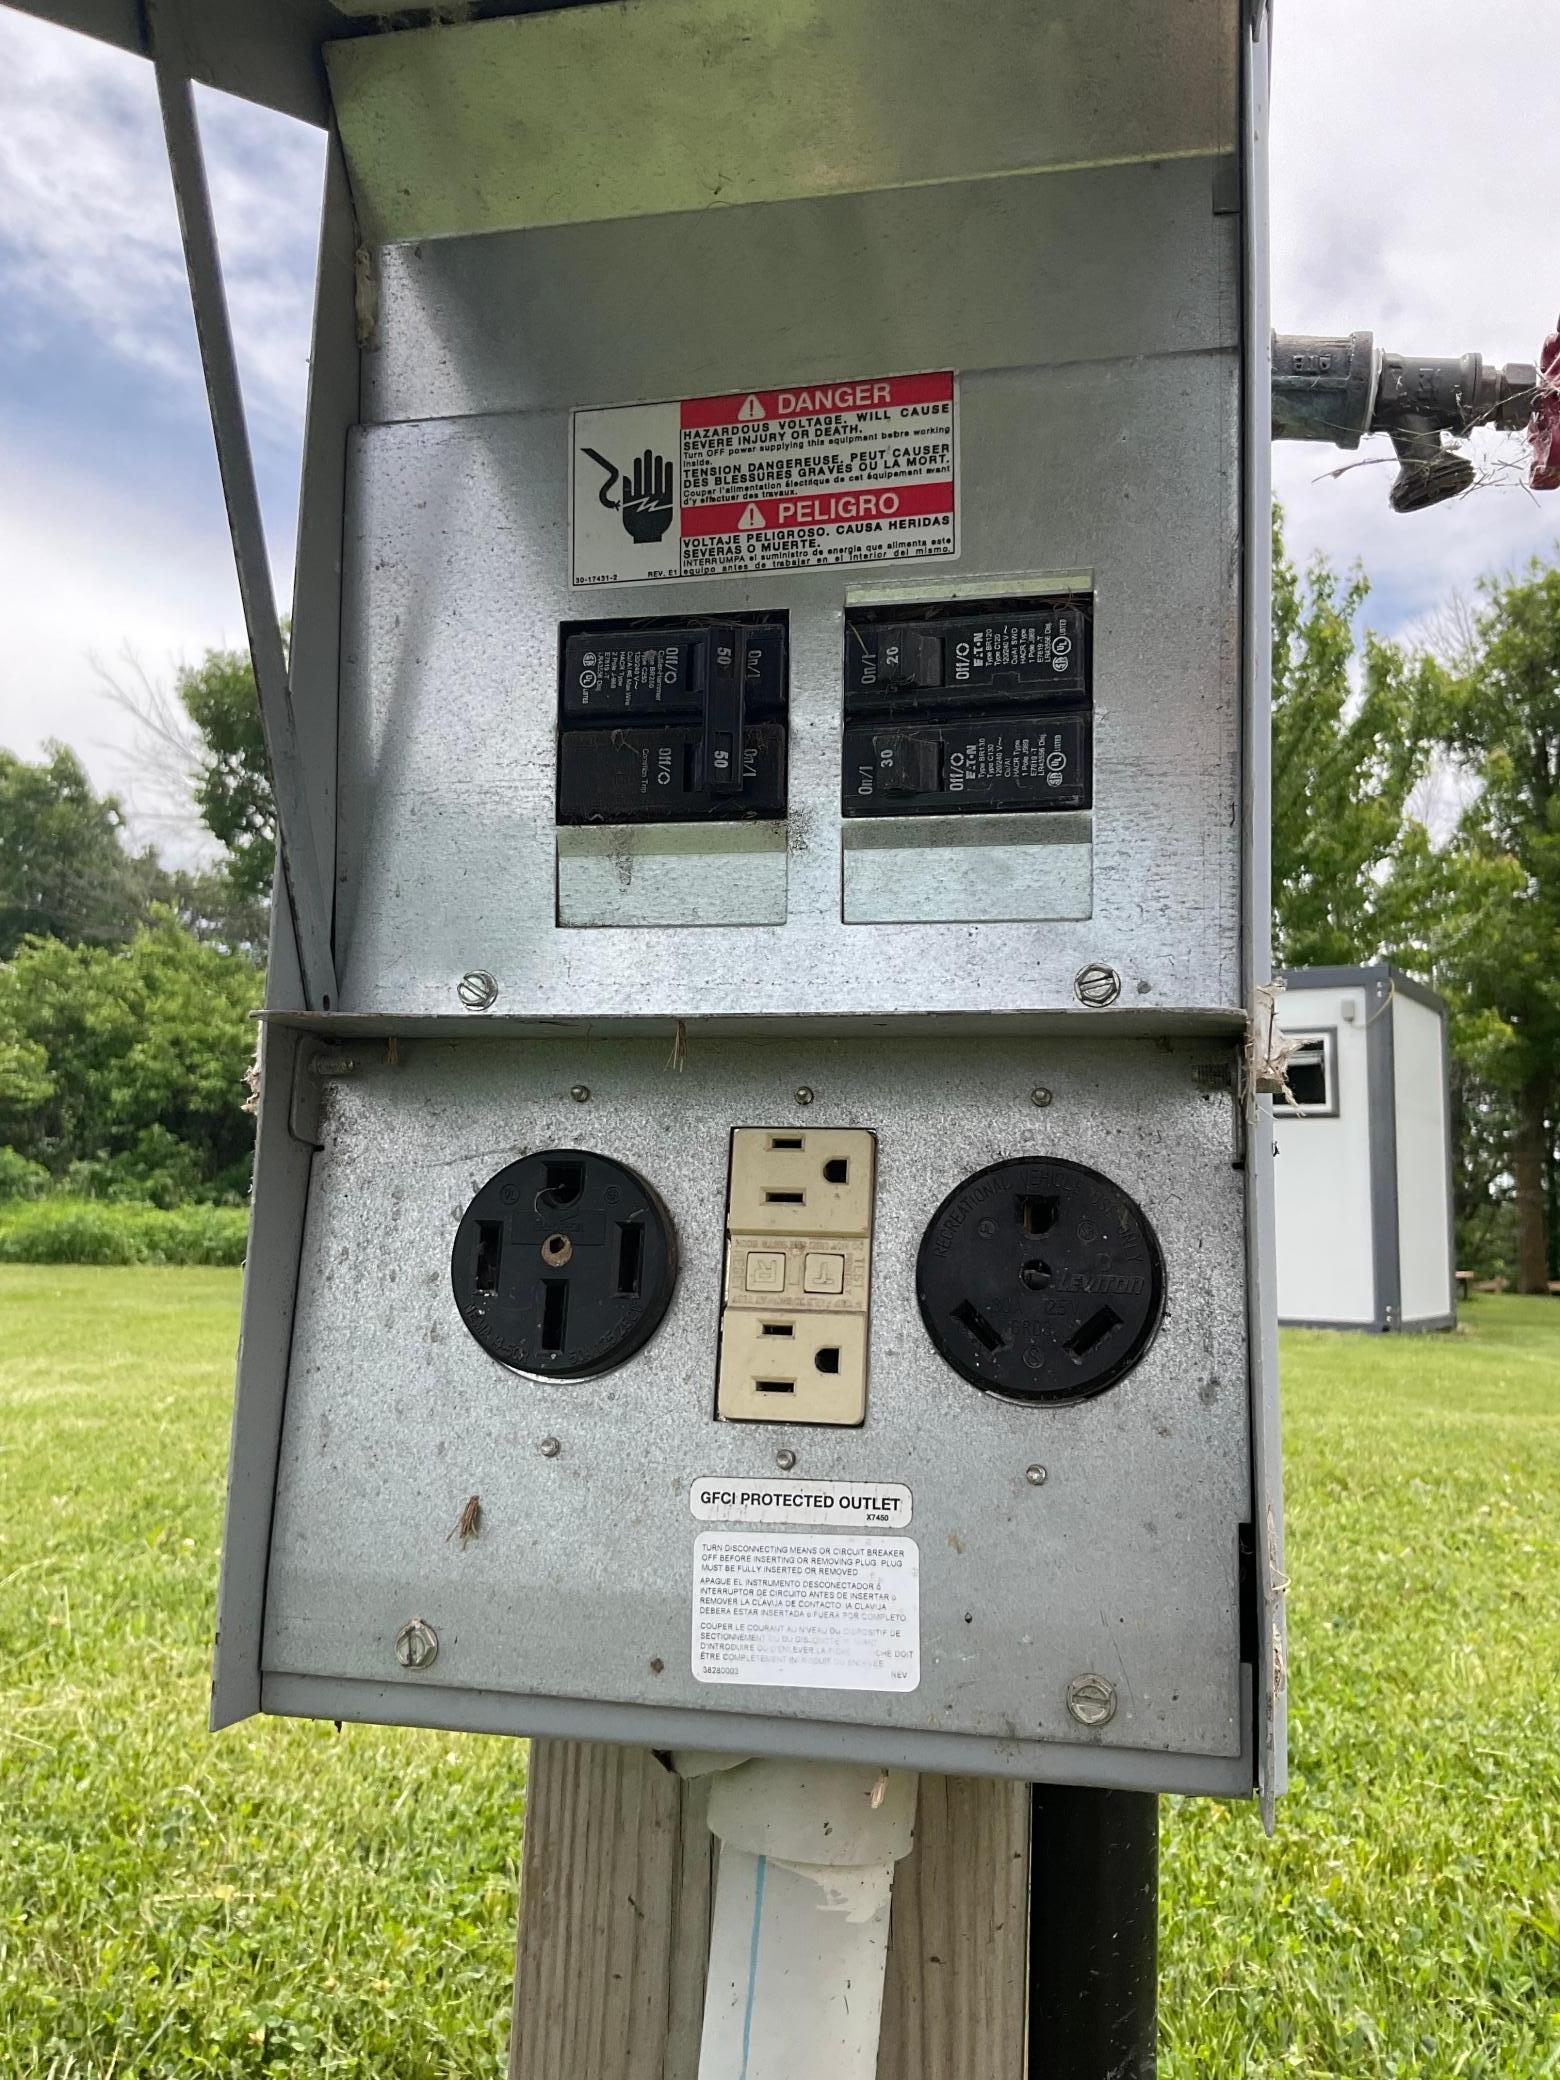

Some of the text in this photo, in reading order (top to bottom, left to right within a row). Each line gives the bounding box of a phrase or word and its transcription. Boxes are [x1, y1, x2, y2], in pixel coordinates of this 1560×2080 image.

[778, 383, 891, 415] DANGER
[684, 404, 949, 440] HAZARDOUS VOLTAGE. WILL CAUSE
[684, 424, 862, 451] SEVERE INJURY OR DEATH.
[684, 451, 703, 459] Turn
[707, 448, 725, 457] OFF
[729, 446, 756, 457] power
[760, 440, 804, 452] supplying
[808, 437, 825, 447] this
[829, 433, 878, 445] equipment
[913, 426, 950, 437] working
[684, 444, 949, 478] TENSION DANGEREUSE. PEUT CAUSER
[684, 454, 950, 489] DES BLESSURES GRAVES OU LA MORT.
[684, 488, 716, 498] Couper
[849, 474, 863, 482] cet
[926, 466, 950, 474] avant
[684, 498, 697, 506] d'y
[762, 489, 797, 498] travaux.
[778, 492, 899, 524] PELIGRO
[684, 516, 949, 548] VOLTAJE PELIGROSO. CAUSA HERIDAS
[684, 539, 820, 559] SEVERAS O MUERTE.
[684, 555, 745, 567] INTERRUMPA
[761, 550, 808, 561] suministro
[812, 548, 823, 556] de
[866, 543, 883, 552] que
[887, 540, 926, 550] alimenta
[931, 537, 951, 545] este
[684, 566, 715, 575] equipo
[722, 563, 748, 572] antes
[773, 558, 810, 567] trabajar
[850, 551, 886, 561] interior
[916, 546, 950, 555] mismo.
[647, 570, 665, 578] REV.
[717, 647, 732, 665] 50
[886, 646, 899, 665] 20
[714, 750, 729, 769] 50
[880, 750, 893, 768] 30
[700, 1491, 901, 1511] GFCI PROTECTED OUTLET
[866, 1513, 889, 1522] X7450
[702, 1543, 904, 1557] TURN DISCONNECTING MEANS OR CIRCUIT BREAKER
[702, 1553, 718, 1561] OFF
[720, 1554, 751, 1562] BEFORE
[754, 1555, 794, 1564] INSERTING
[797, 1556, 808, 1564] OR
[811, 1557, 853, 1566] REMOVING
[881, 1559, 902, 1568] PLUG
[725, 1564, 735, 1572] BE
[738, 1565, 761, 1573] FULLY
[764, 1565, 802, 1574] INSERTED
[700, 1577, 731, 1585] APAGUE
[746, 1579, 800, 1588] INSTRUMENTO
[803, 1580, 874, 1590] DESCONECTADOR
[700, 1587, 754, 1595] INTERRUPTOR
[770, 1589, 807, 1597] CIRCUITO
[809, 1591, 834, 1599] ANTES
[837, 1591, 847, 1599] DE
[850, 1592, 889, 1600] INSERTAR
[700, 1597, 737, 1605] REMOVER
[752, 1598, 783, 1607] CLAVIJA
[798, 1600, 841, 1609] CONTACTO
[855, 1602, 886, 1610] CLAVIJA
[700, 1606, 731, 1614] DEBERA
[734, 1607, 758, 1615] ESTAR
[761, 1609, 804, 1618] INSERTADA
[701, 1622, 732, 1630] COUPER
[736, 1623, 745, 1631] LE
